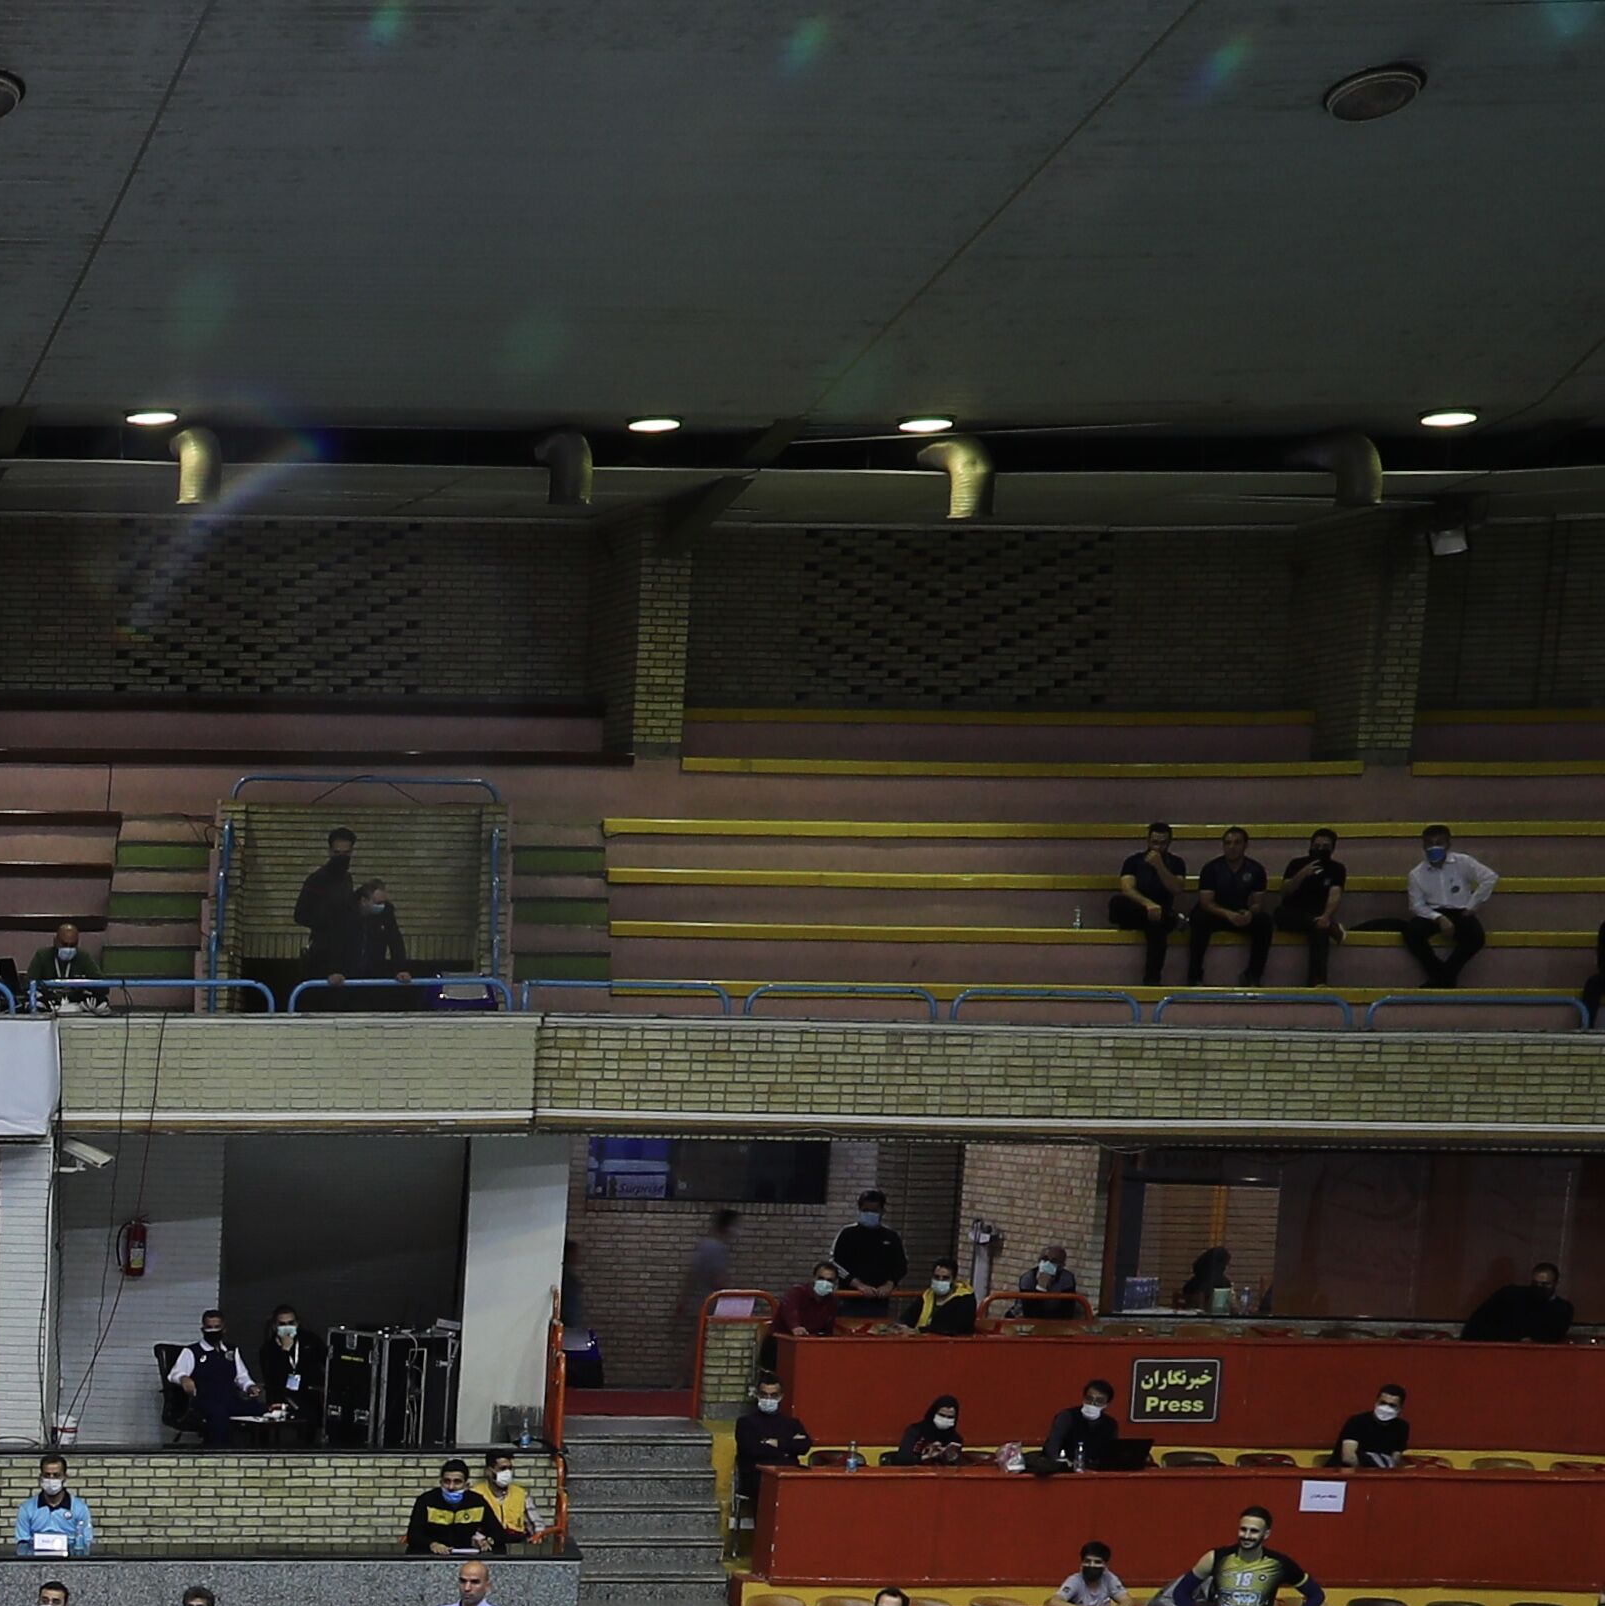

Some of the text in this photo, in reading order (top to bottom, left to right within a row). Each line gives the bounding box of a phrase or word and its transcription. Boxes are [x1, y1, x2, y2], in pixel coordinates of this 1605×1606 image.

[1140, 1369, 1213, 1391] خبرنگاران
[1145, 1396, 1205, 1413] Press
[1235, 1572, 1254, 1587] 18
